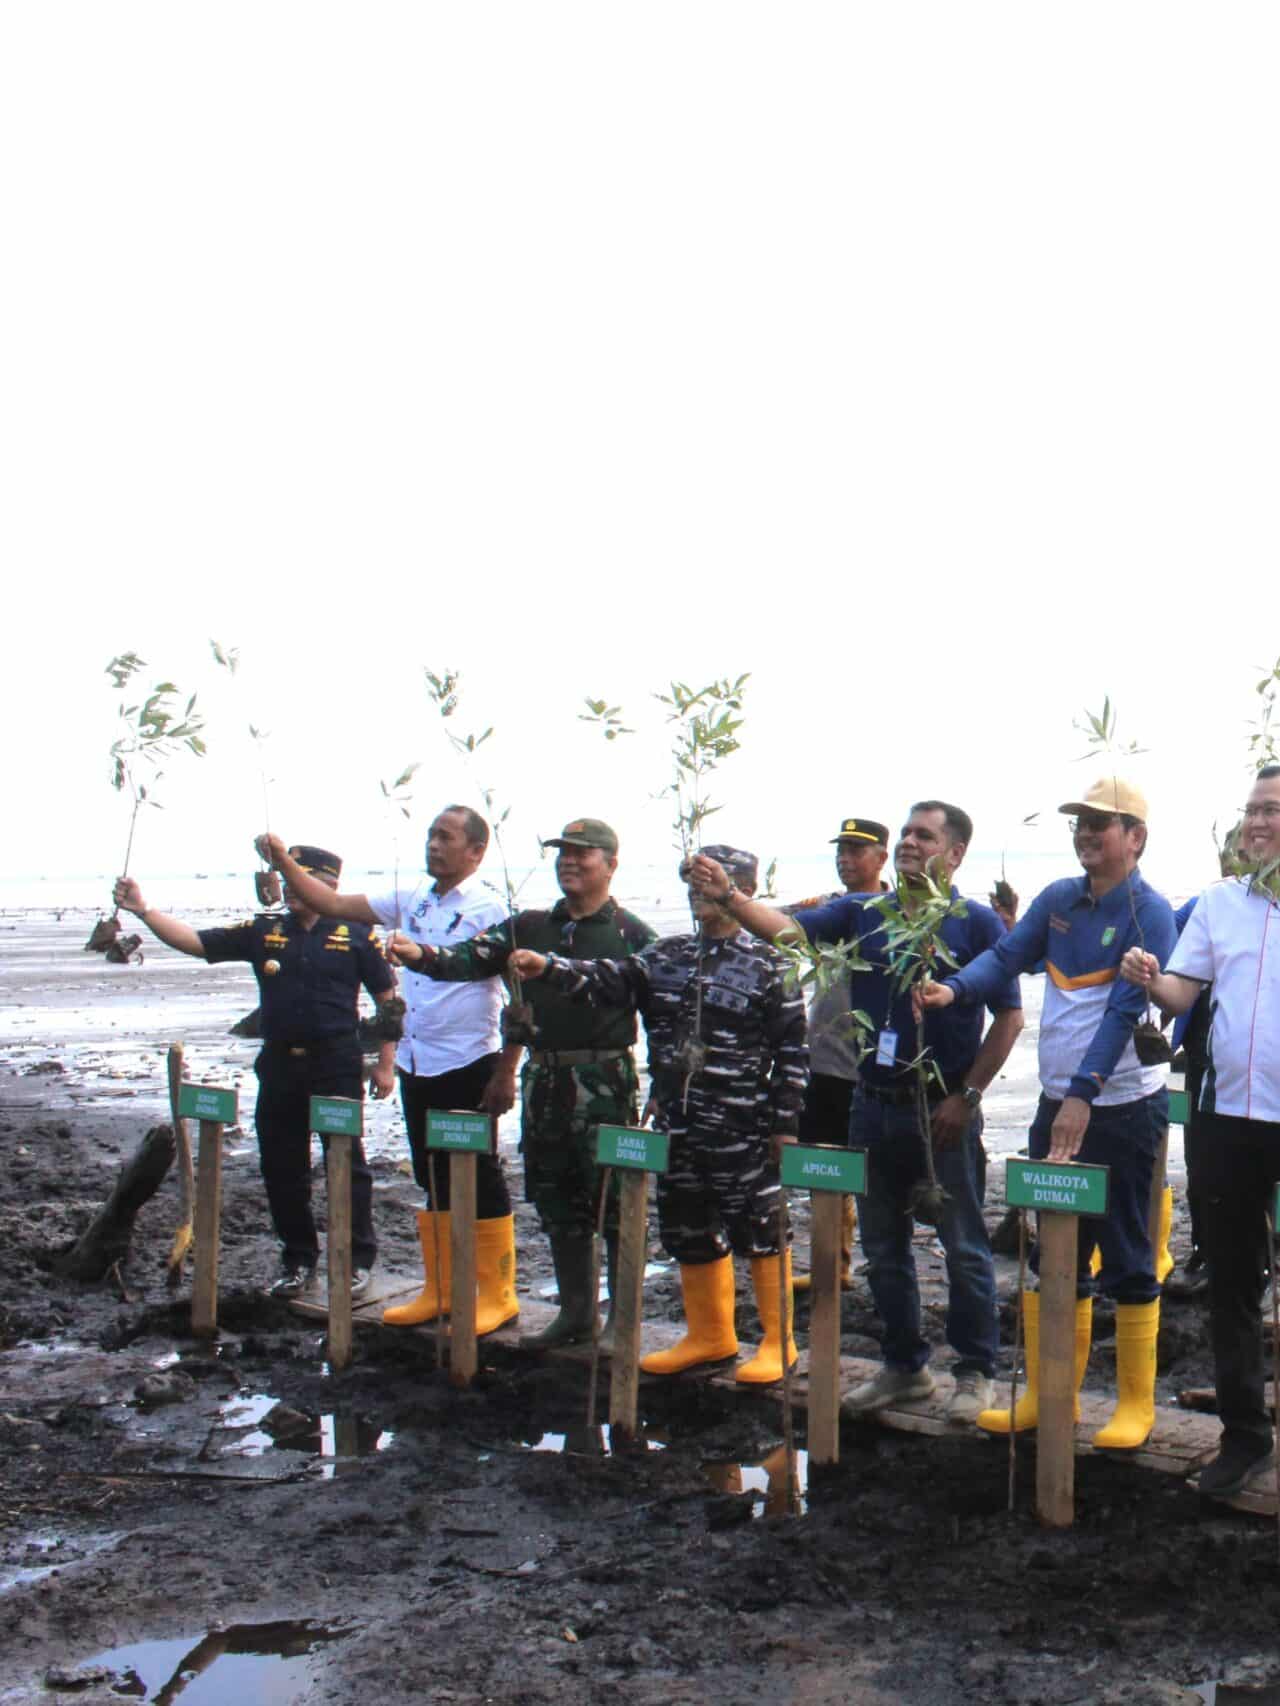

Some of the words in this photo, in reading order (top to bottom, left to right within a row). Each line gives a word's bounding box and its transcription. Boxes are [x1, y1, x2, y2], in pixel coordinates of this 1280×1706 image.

[802, 1162, 841, 1177] APICAL
[1022, 1171, 1089, 1190] WALIKOTA
[1033, 1188, 1076, 1205] DUMAI
